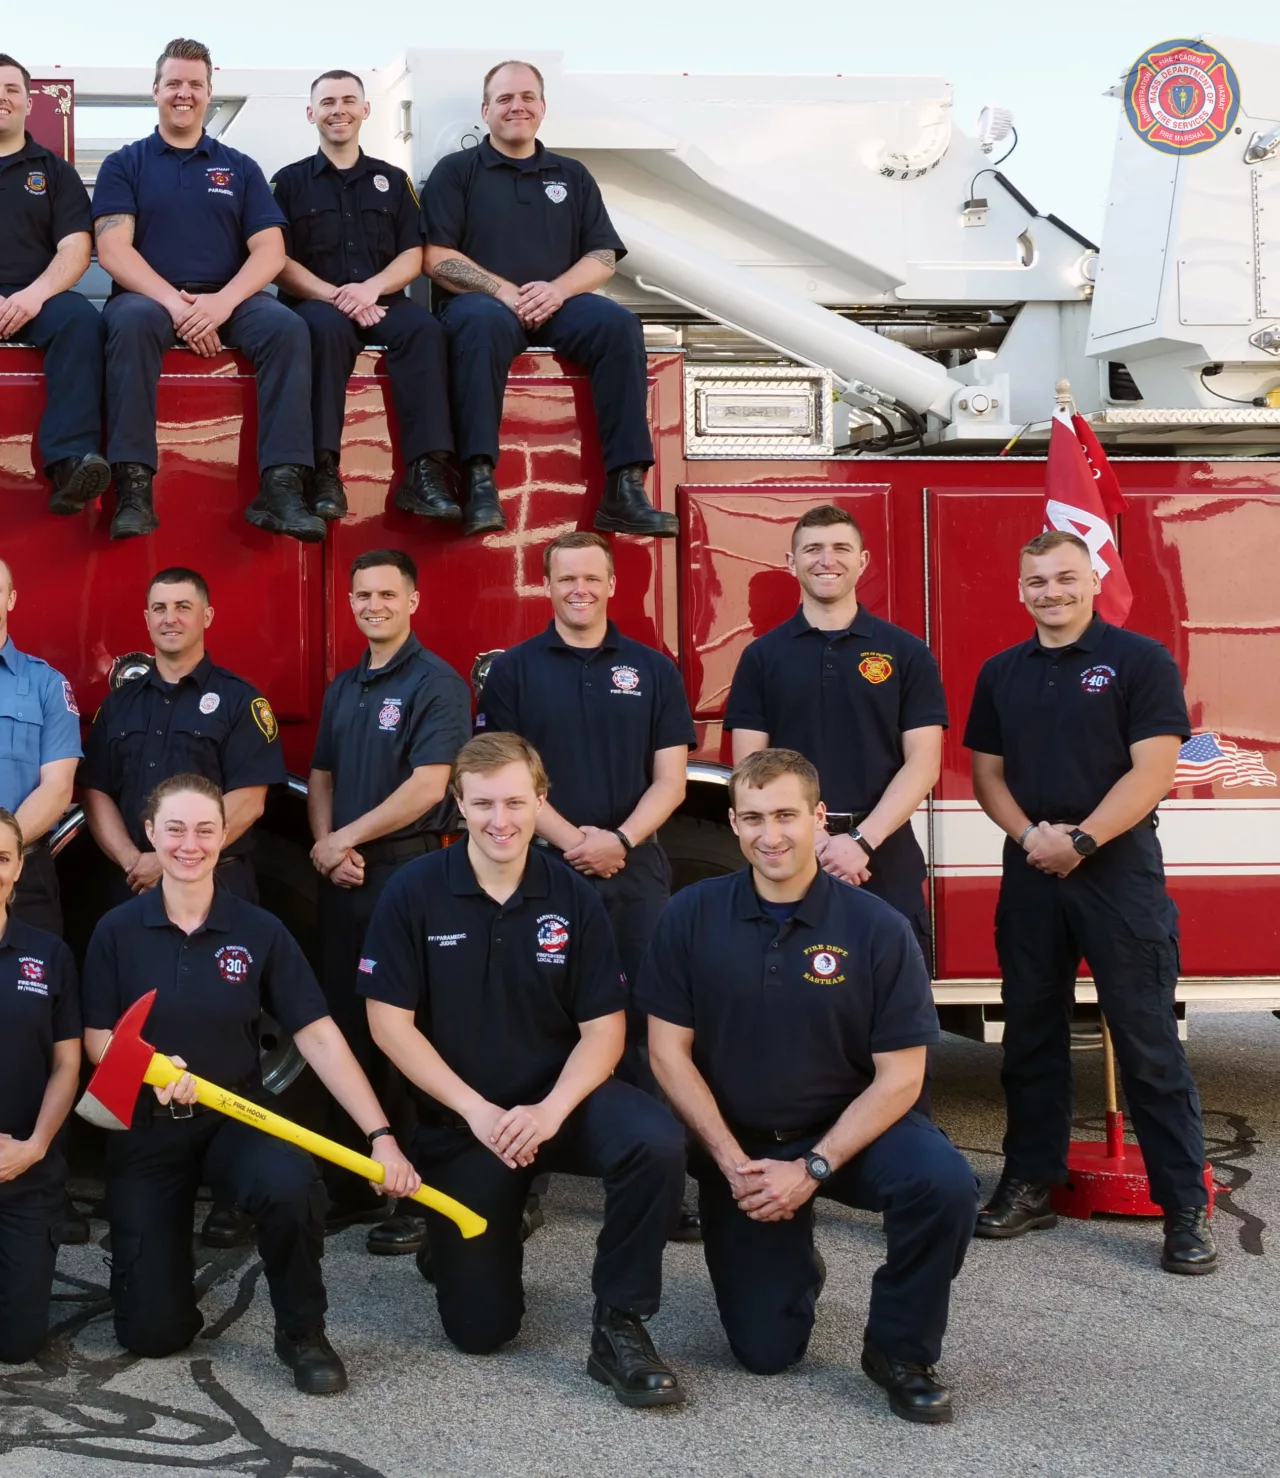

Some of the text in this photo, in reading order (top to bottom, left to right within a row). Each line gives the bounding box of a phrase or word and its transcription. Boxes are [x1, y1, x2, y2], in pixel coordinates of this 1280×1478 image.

[1159, 53, 1206, 66] FIRE ACADEMY
[1160, 65, 1212, 89] DEPARTMENT
[1206, 93, 1214, 105] OF
[1138, 71, 1152, 123] ADMINISTRATION
[1217, 84, 1226, 111] HAZMAT
[1154, 110, 1209, 130] FIRE SERVICES
[1158, 129, 1206, 142] FIRE MARSHAL
[901, 171, 909, 180] 0
[915, 167, 927, 178] 20
[1087, 674, 1105, 687] 40
[803, 944, 824, 956] FIRE
[226, 958, 242, 974] 30
[803, 971, 846, 985] EASTHAM
[232, 1100, 246, 1112] FIRE
